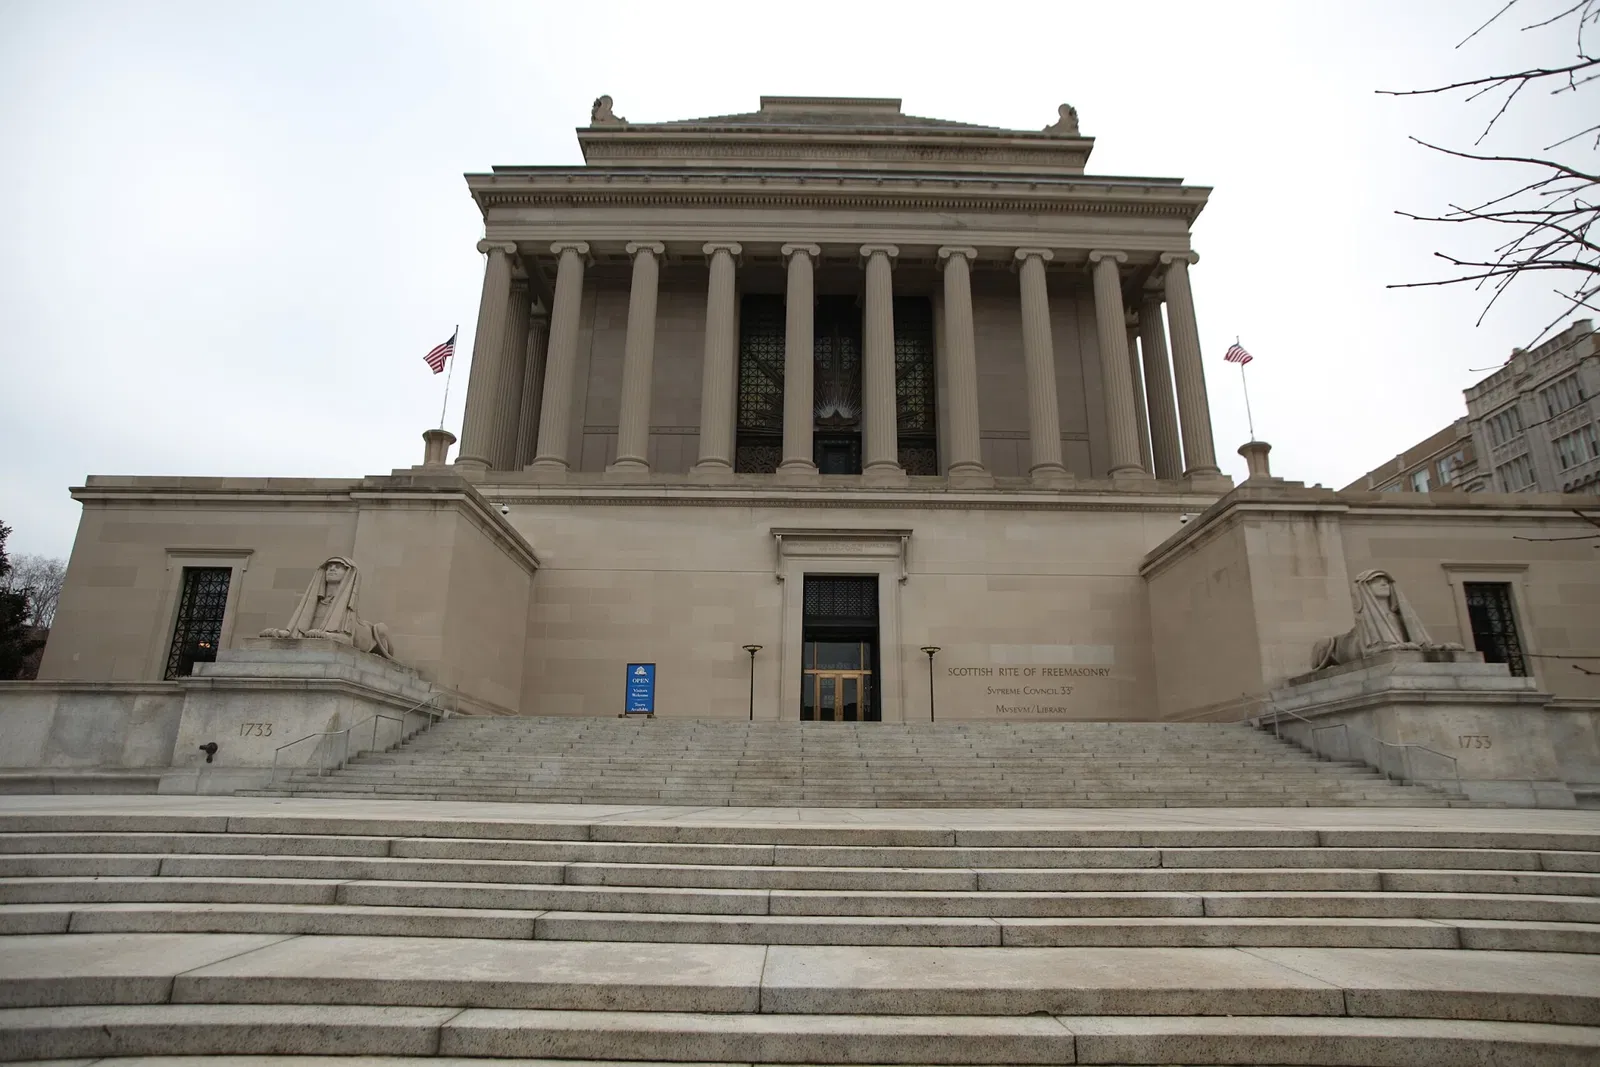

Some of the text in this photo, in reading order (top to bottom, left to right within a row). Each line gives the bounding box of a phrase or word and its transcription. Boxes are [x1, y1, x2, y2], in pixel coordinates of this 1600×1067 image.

[948, 668, 1110, 676] SCOTTISH RITE OF FREEMASONRY
[240, 722, 273, 737] 1733
[1458, 735, 1492, 749] 1733
